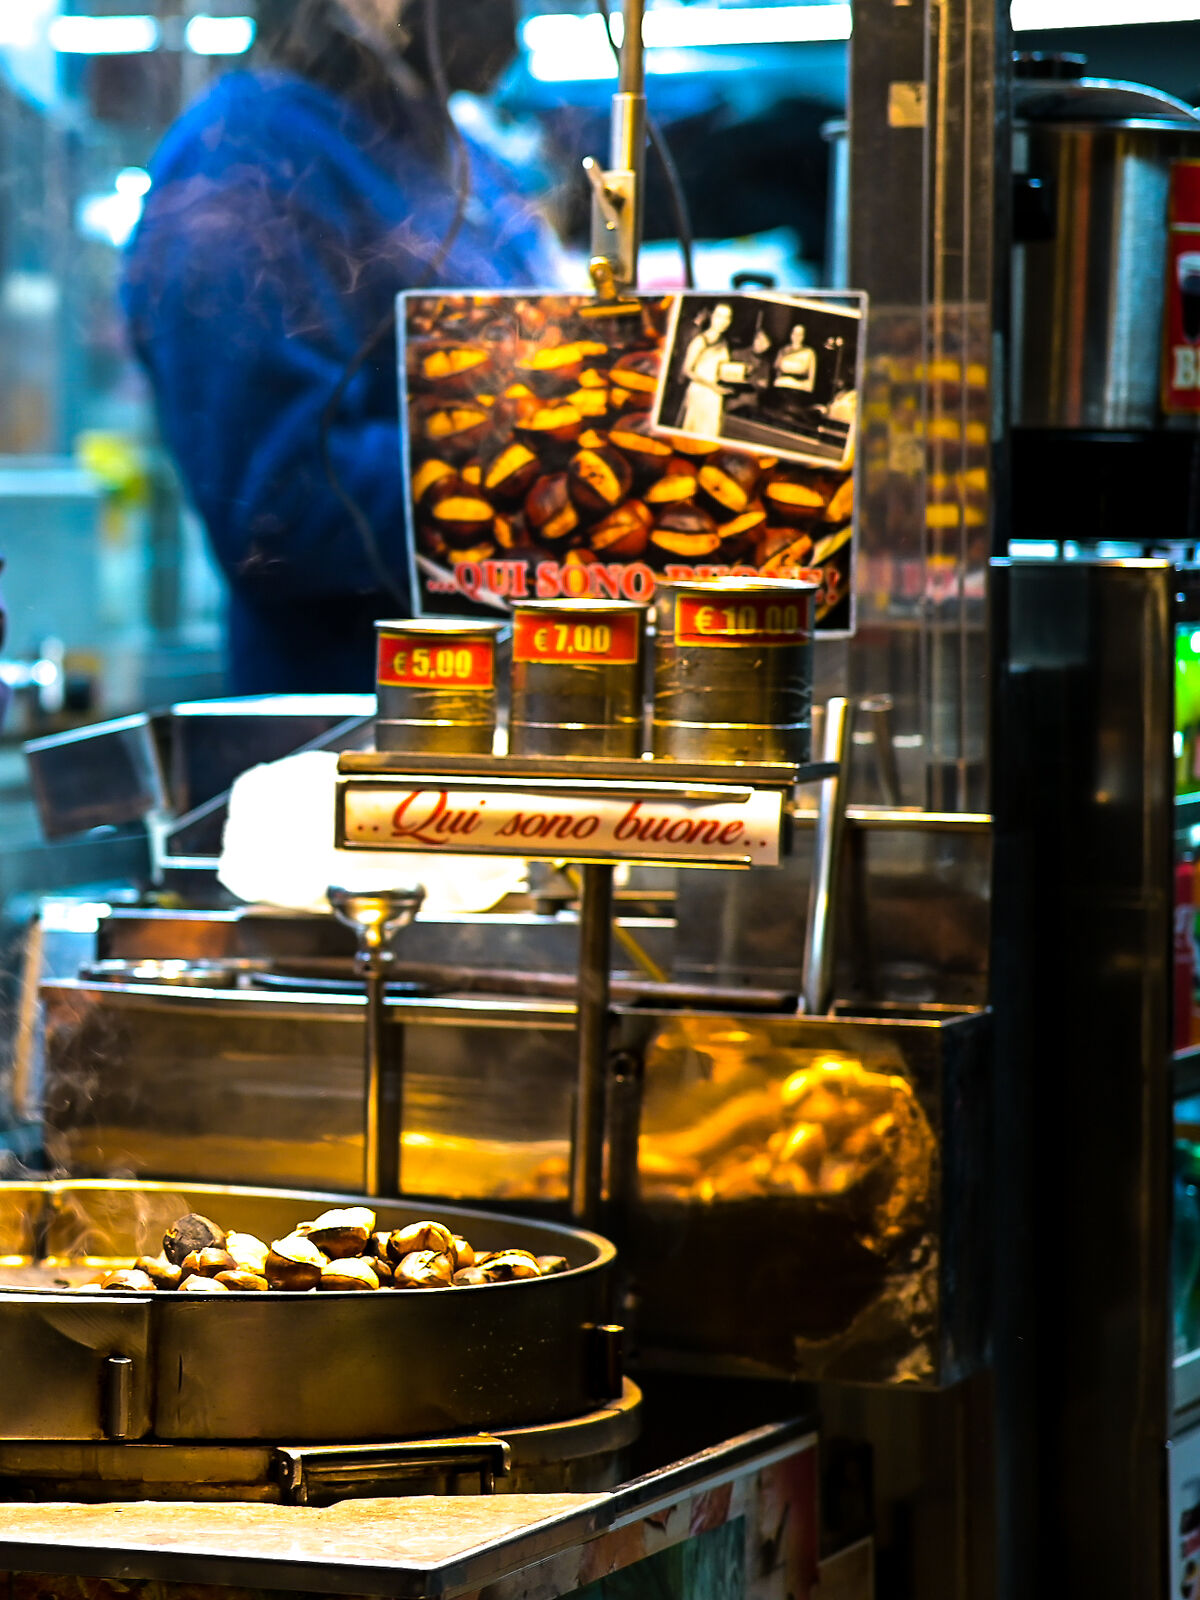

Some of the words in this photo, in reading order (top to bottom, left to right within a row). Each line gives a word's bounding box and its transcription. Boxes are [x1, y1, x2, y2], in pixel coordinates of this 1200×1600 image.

[536, 560, 655, 601] SONO
[694, 606, 716, 635] €
[533, 628, 548, 652] €
[554, 624, 611, 654] 7,00
[393, 651, 407, 676] €
[412, 648, 472, 679] 5,00
[495, 812, 599, 840] sono
